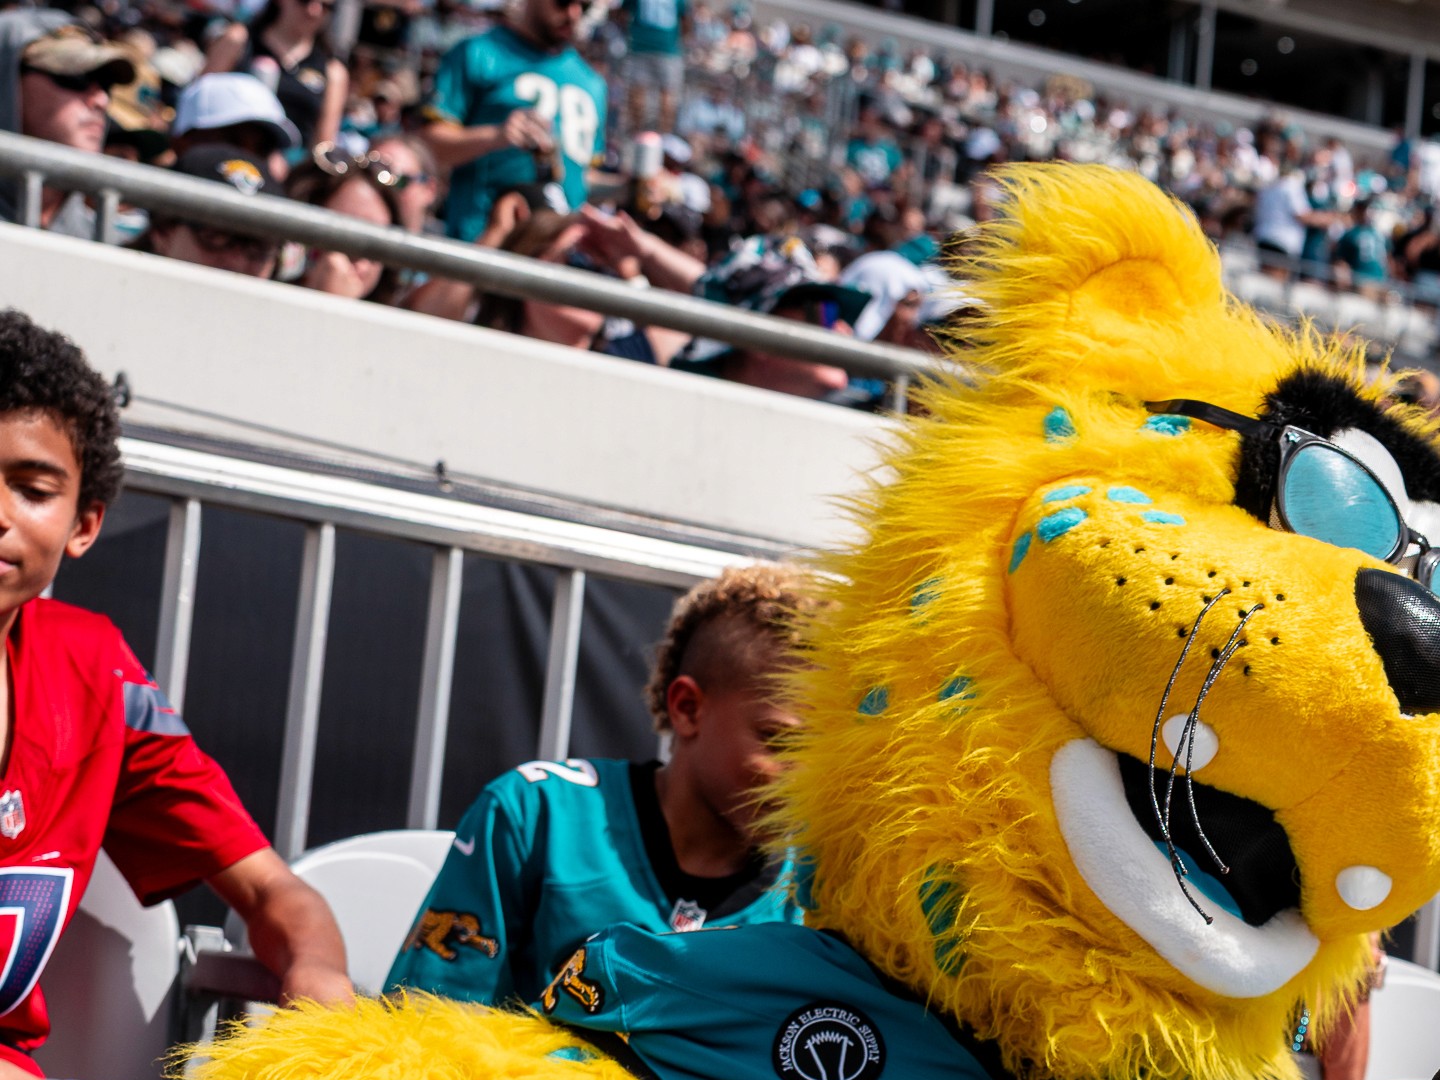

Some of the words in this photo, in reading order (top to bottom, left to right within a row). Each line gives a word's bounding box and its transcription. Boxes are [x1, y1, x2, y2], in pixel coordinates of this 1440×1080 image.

[778, 1021, 801, 1073] JACKSON
[798, 1006, 861, 1026] ELECTRIC
[858, 1023, 881, 1065] SUPPLY
